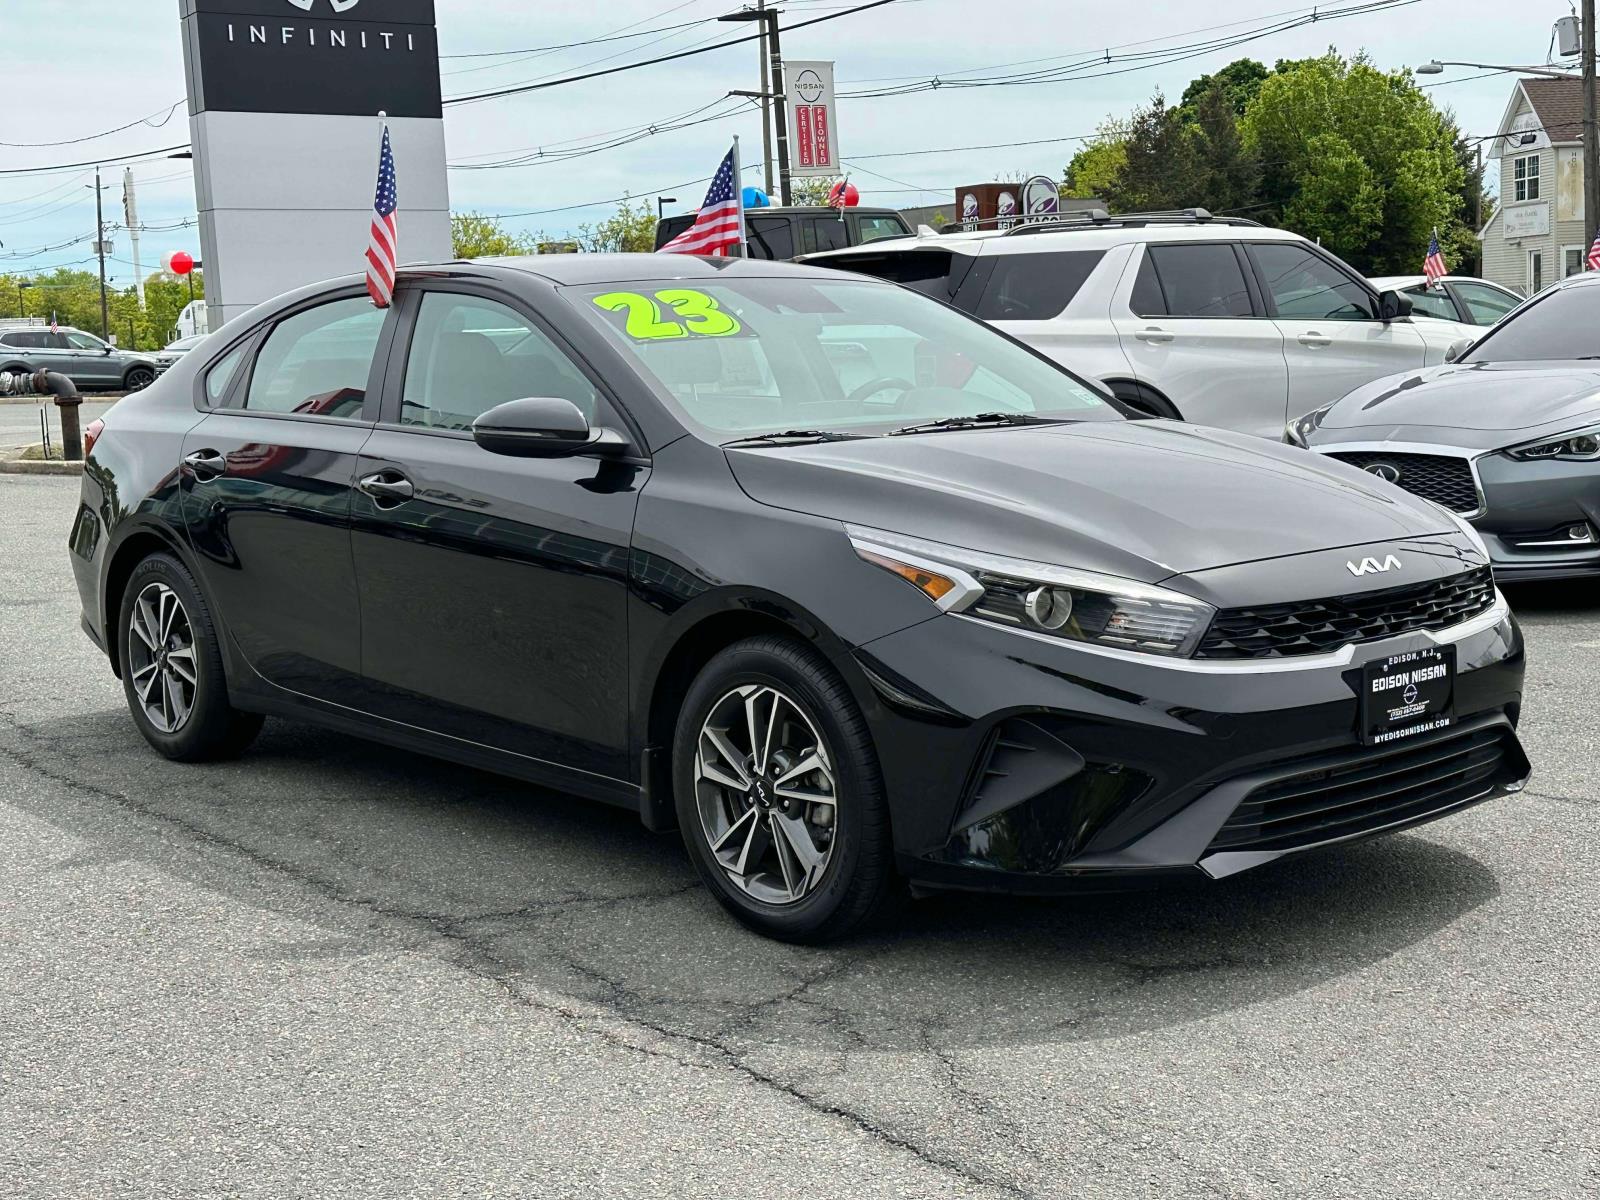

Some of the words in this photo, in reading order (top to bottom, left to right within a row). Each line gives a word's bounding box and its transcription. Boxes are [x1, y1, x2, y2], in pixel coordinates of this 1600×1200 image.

[228, 24, 413, 50] INFINITI
[800, 108, 810, 164] CERTIFIED
[592, 289, 741, 340] 23
[1346, 554, 1402, 577] KIA
[1388, 652, 1420, 665] EDISON,
[1372, 672, 1410, 693] EDISON
[1411, 663, 1447, 684] NISSAN
[1374, 718, 1450, 744] MYEDISONNISSAN.COM
